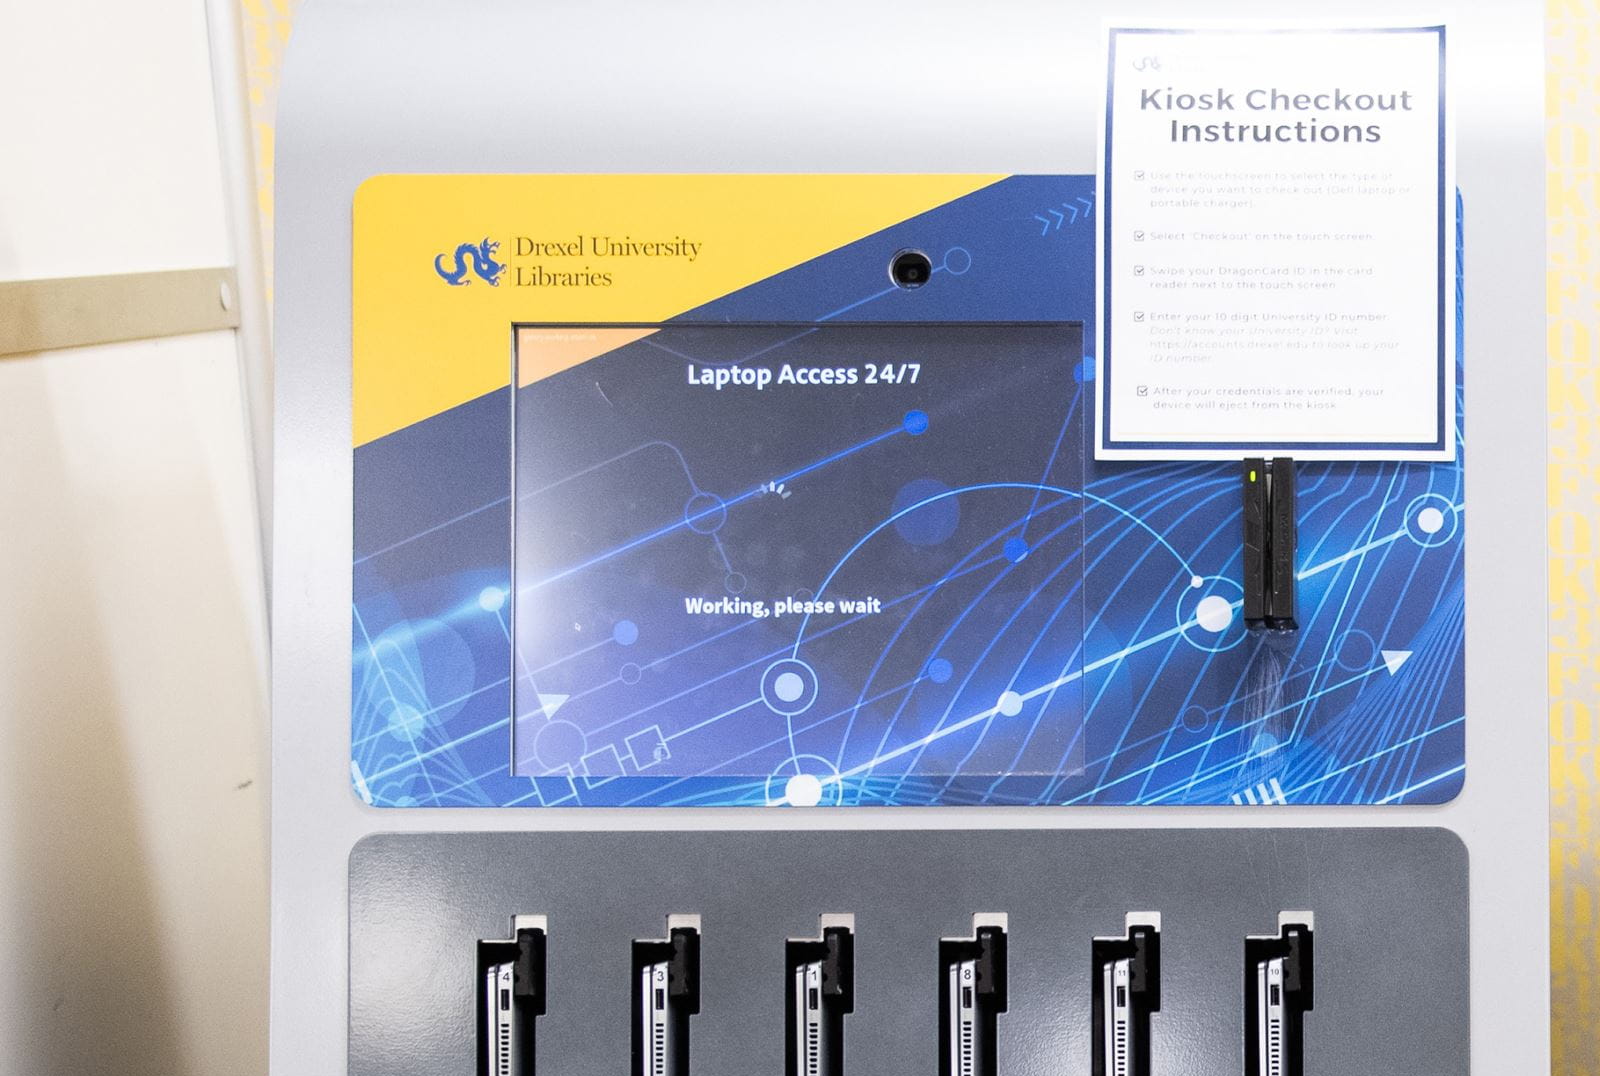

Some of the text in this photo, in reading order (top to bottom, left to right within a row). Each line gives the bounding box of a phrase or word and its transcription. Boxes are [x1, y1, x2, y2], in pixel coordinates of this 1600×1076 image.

[1141, 87, 1412, 110] Kiosk Checkout
[1172, 118, 1380, 142] Instructions
[517, 236, 701, 261] Drexel University
[517, 266, 612, 286] Libraries
[1150, 312, 1390, 323] Enter your 10 digit University ID number.
[689, 364, 920, 390] Laptop Access 24/7
[685, 597, 881, 618] Working, please wait
[502, 971, 511, 982] 4
[656, 970, 665, 983] 3
[811, 970, 817, 981] 1
[963, 968, 972, 981] 8
[1117, 969, 1126, 977] 11
[1270, 968, 1280, 976] 10
